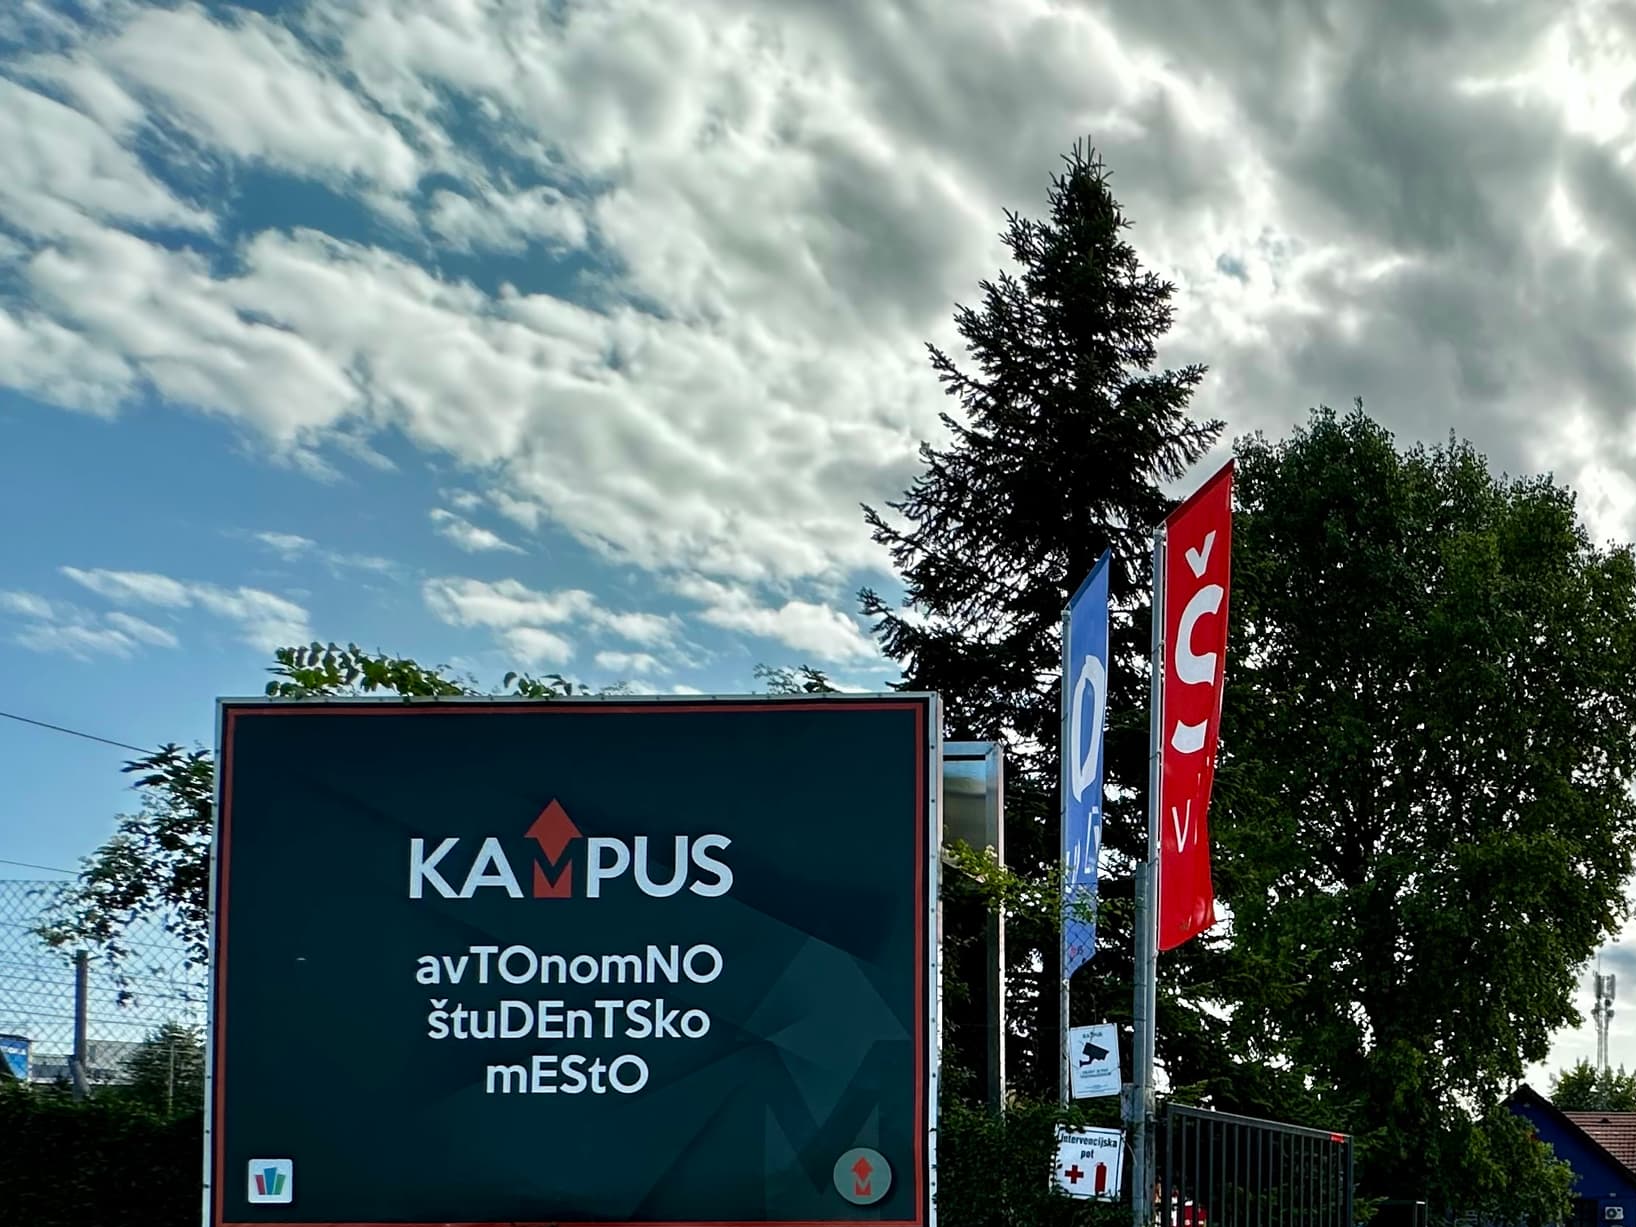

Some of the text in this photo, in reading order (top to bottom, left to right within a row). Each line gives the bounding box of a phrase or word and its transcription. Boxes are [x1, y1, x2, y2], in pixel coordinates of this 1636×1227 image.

[409, 832, 734, 899] KAMPUS
[415, 943, 723, 985] avTOnomNO
[427, 997, 711, 1040] štuDEnTSko
[486, 1054, 649, 1094] mEStO
[1080, 1149, 1094, 1160] pot
